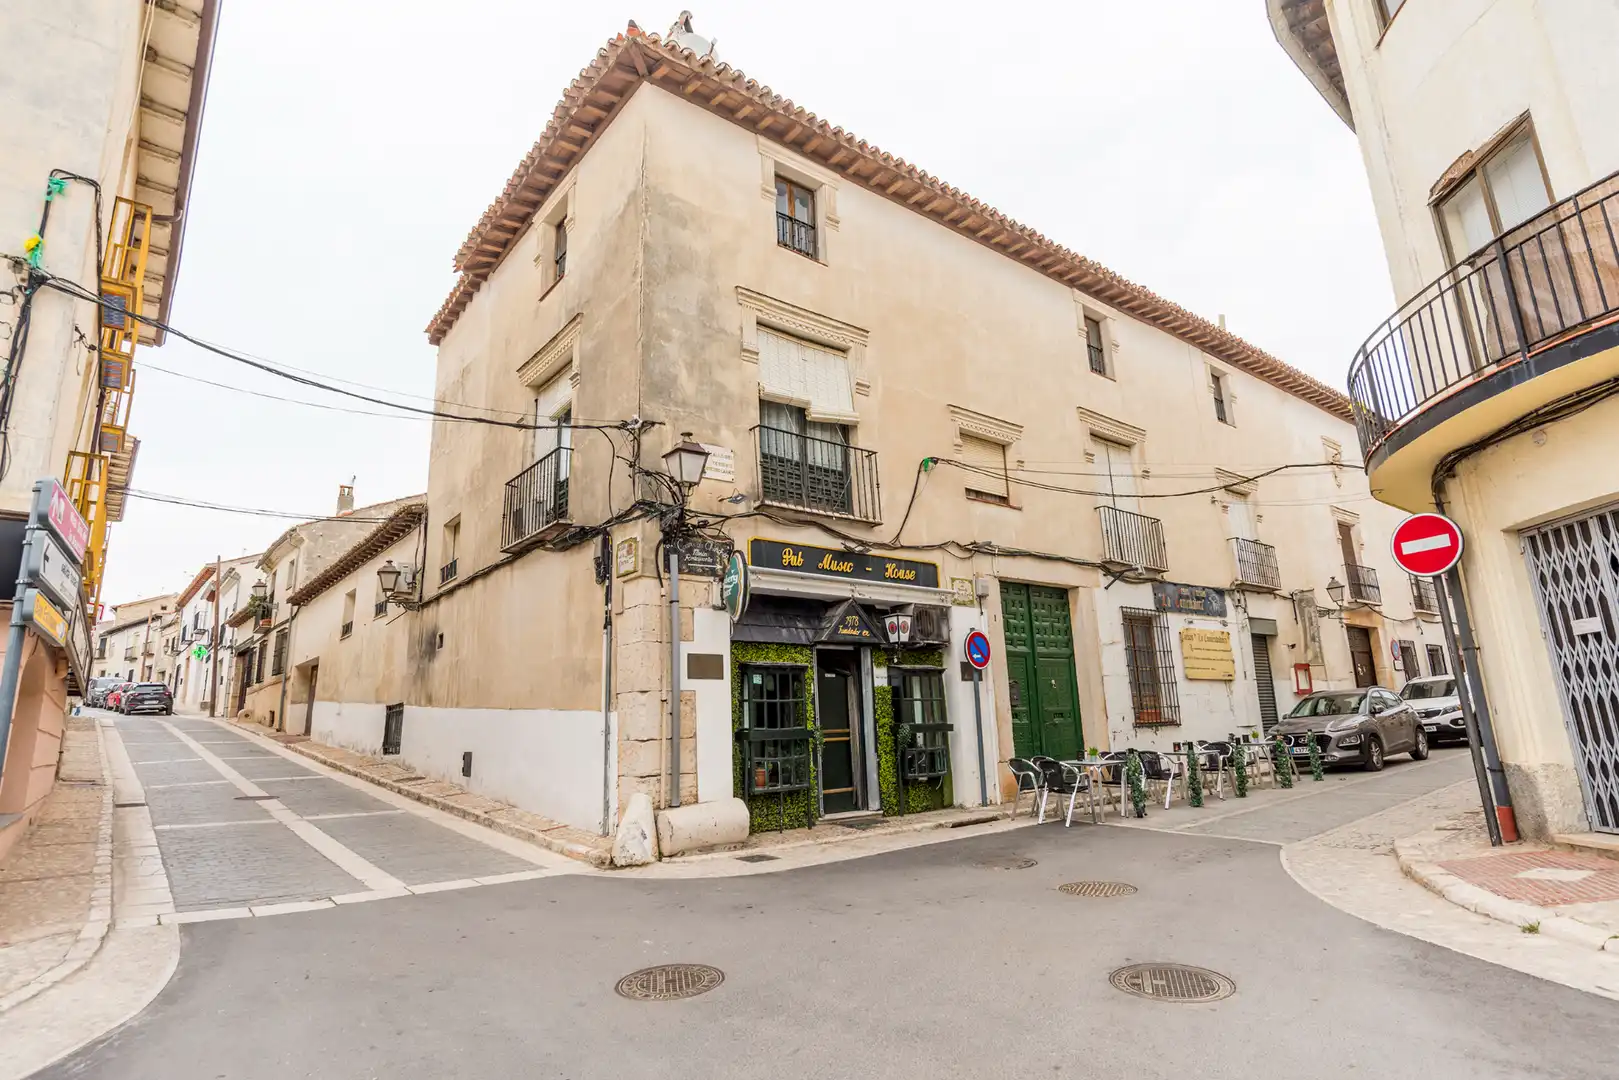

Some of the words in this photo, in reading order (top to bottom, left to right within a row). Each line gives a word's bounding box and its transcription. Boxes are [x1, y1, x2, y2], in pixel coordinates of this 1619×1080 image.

[782, 548, 804, 567] Pub
[818, 553, 854, 573] Music
[885, 562, 916, 581] House
[845, 615, 859, 626] 1978
